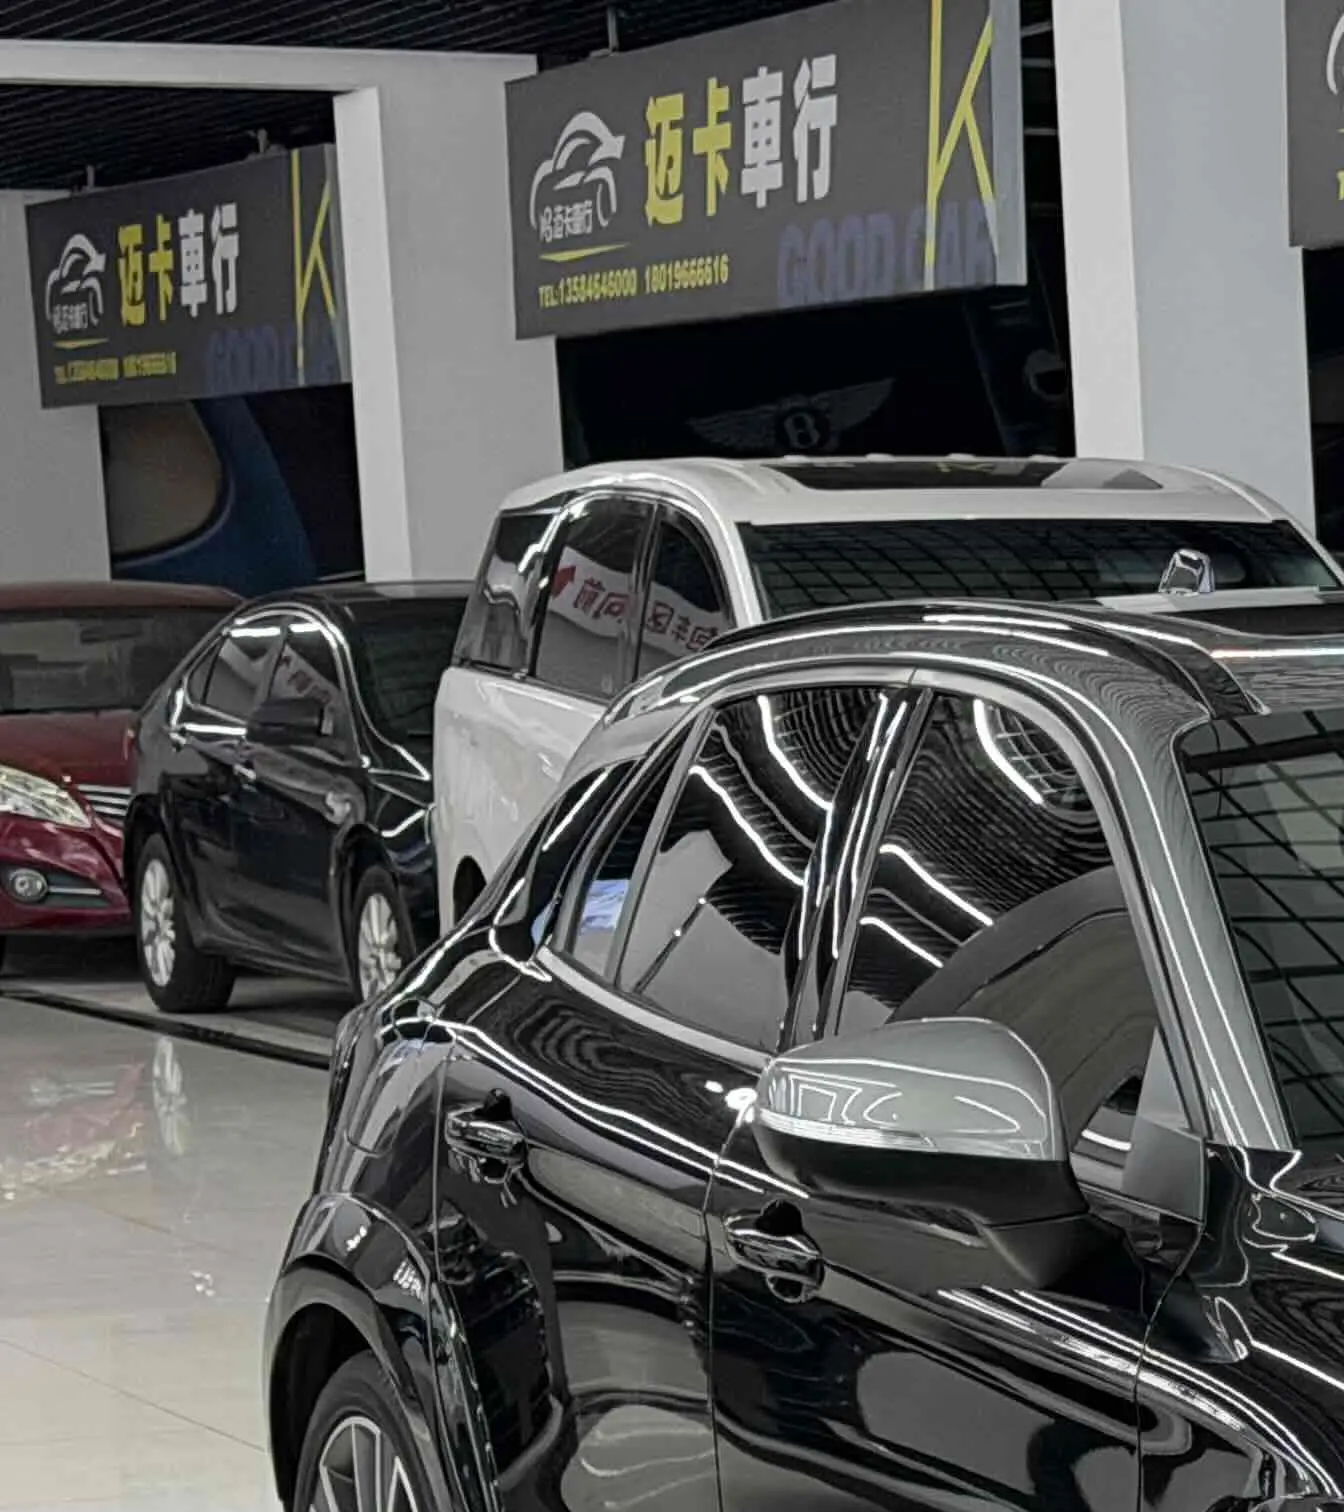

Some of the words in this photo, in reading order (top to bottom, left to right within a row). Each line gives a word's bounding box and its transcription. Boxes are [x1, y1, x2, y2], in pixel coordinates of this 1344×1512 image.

[645, 53, 837, 226] 迈卡車行
[117, 202, 240, 328] 迈卡車行
[777, 213, 896, 309] GOOD
